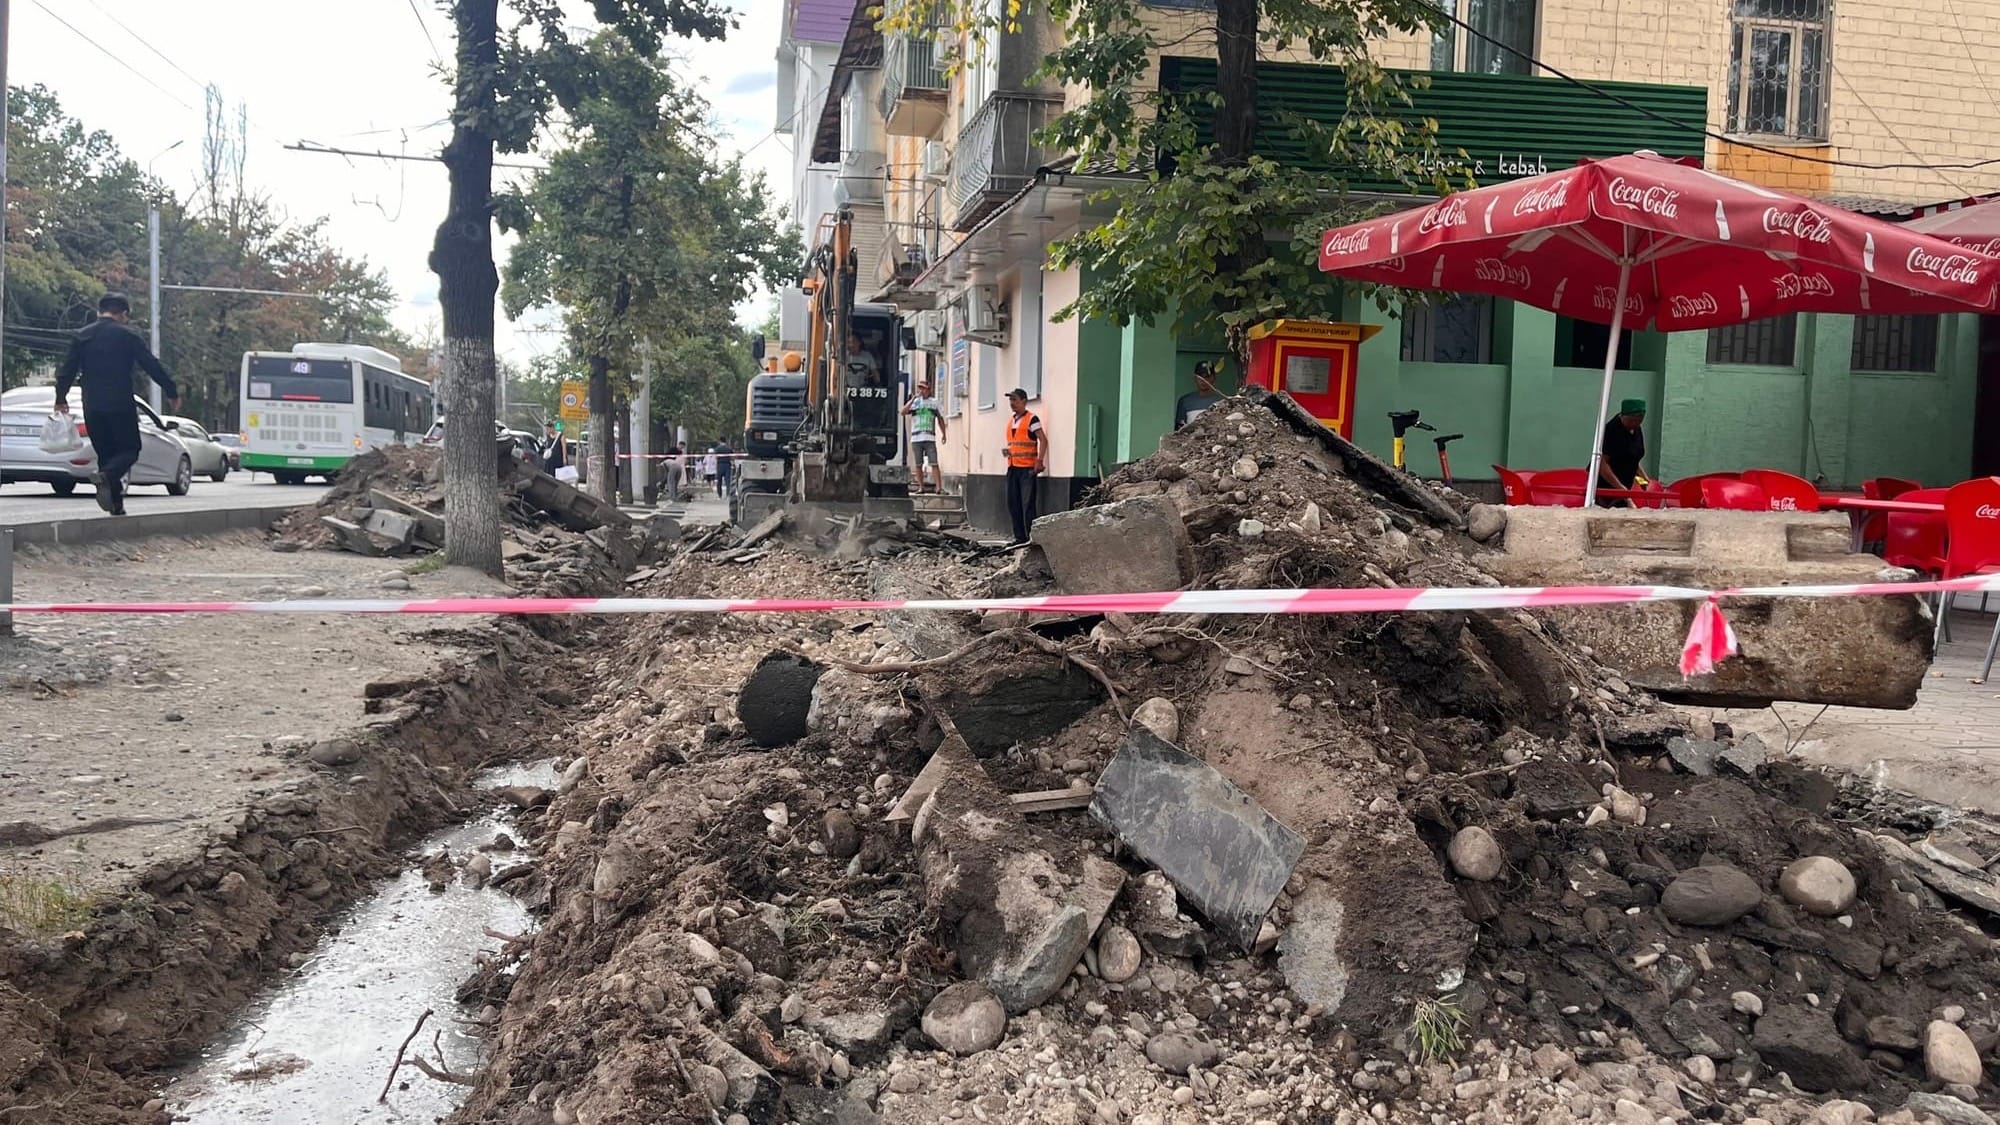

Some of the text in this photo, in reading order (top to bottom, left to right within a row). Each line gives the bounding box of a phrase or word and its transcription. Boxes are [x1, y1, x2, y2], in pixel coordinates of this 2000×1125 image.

[1474, 160, 1486, 175] &
[1499, 153, 1547, 176] kebab
[1609, 176, 1680, 220] Coca-Cola
[1762, 206, 1832, 245] Coca-Cola
[1906, 246, 1981, 285] Coca-Cola
[294, 361, 309, 374] 49
[859, 387, 872, 398] 38
[874, 388, 888, 398] 75
